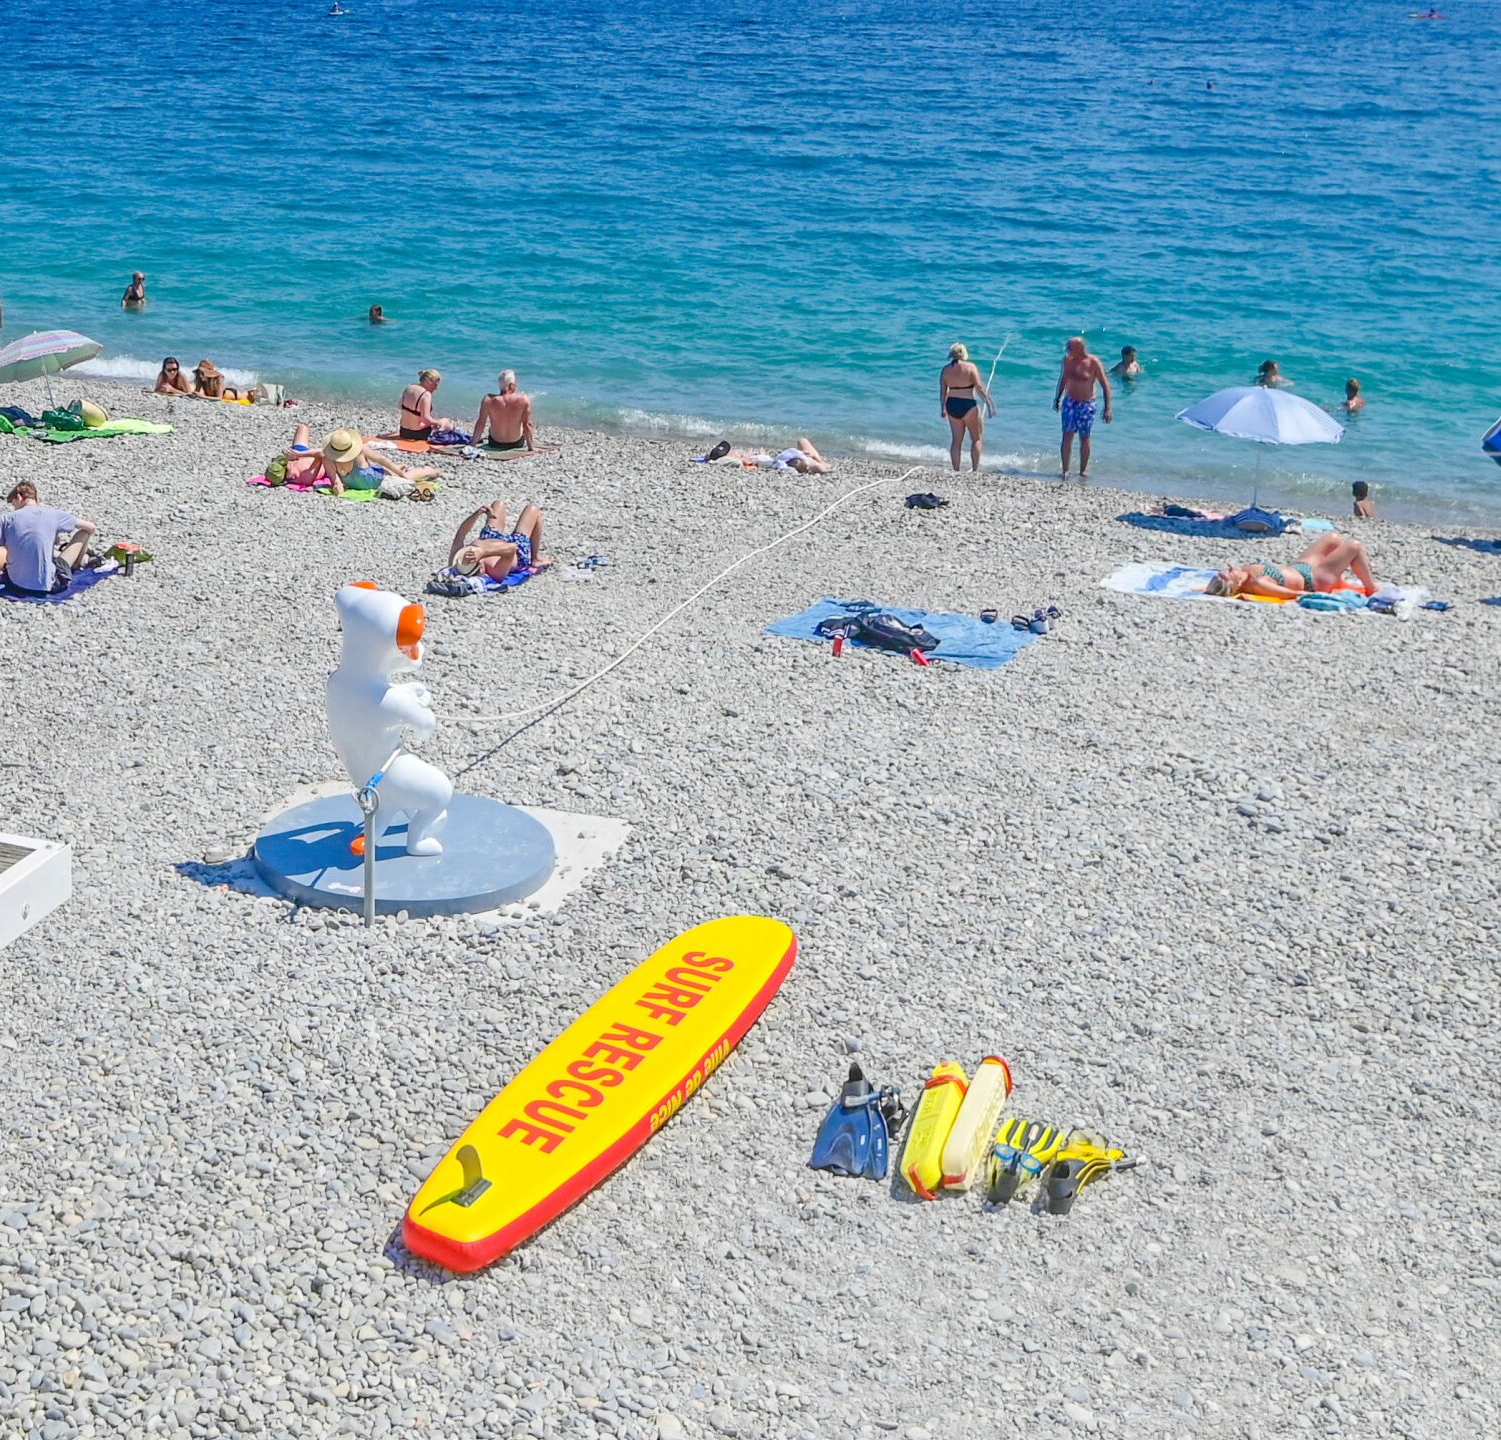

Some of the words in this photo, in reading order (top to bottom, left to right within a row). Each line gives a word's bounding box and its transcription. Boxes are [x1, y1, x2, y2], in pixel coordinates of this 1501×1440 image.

[634, 951, 735, 1027] SURF
[703, 1038, 732, 1077] Ville
[496, 1022, 665, 1155] RESCUE
[685, 1070, 703, 1099] de
[649, 1089, 684, 1134] Nice
